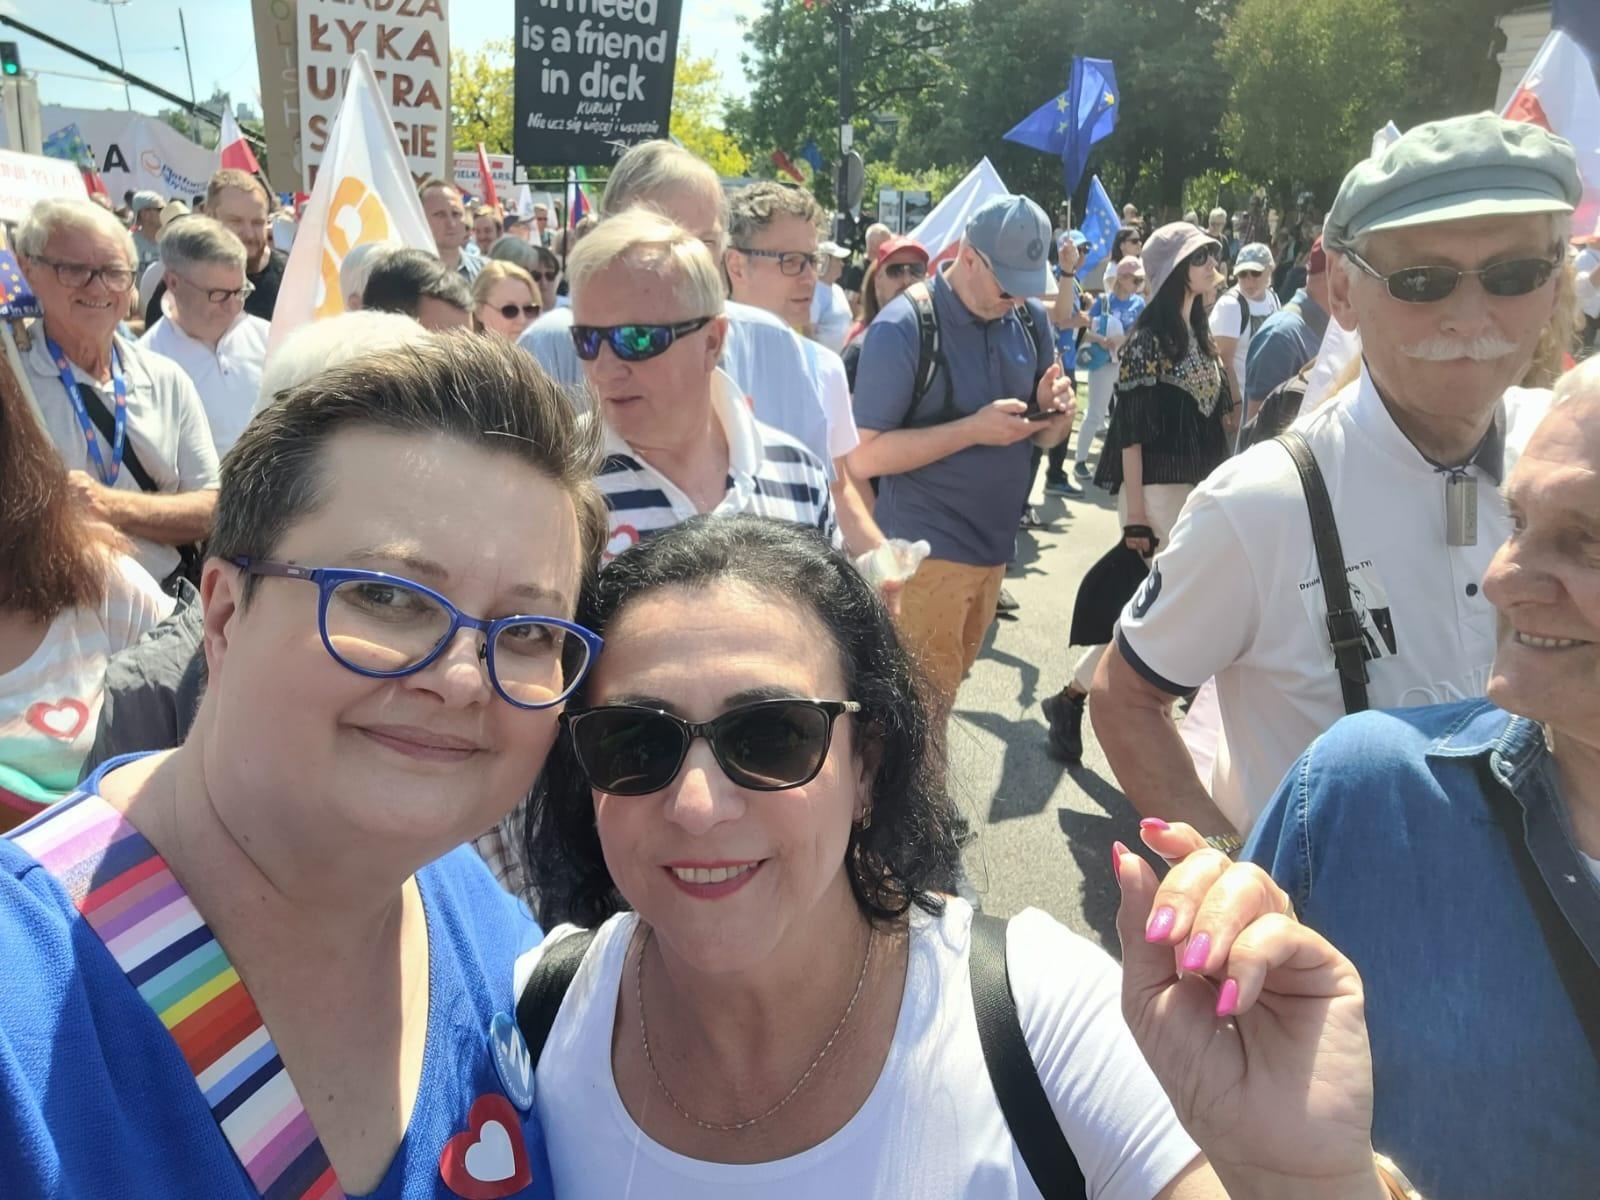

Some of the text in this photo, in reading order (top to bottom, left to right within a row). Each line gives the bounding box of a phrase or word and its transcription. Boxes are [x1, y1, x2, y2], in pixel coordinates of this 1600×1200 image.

[308, 14, 442, 68] ŁYKA
[522, 16, 667, 64] is a friend
[307, 65, 442, 110] URA
[541, 57, 646, 101] in dick
